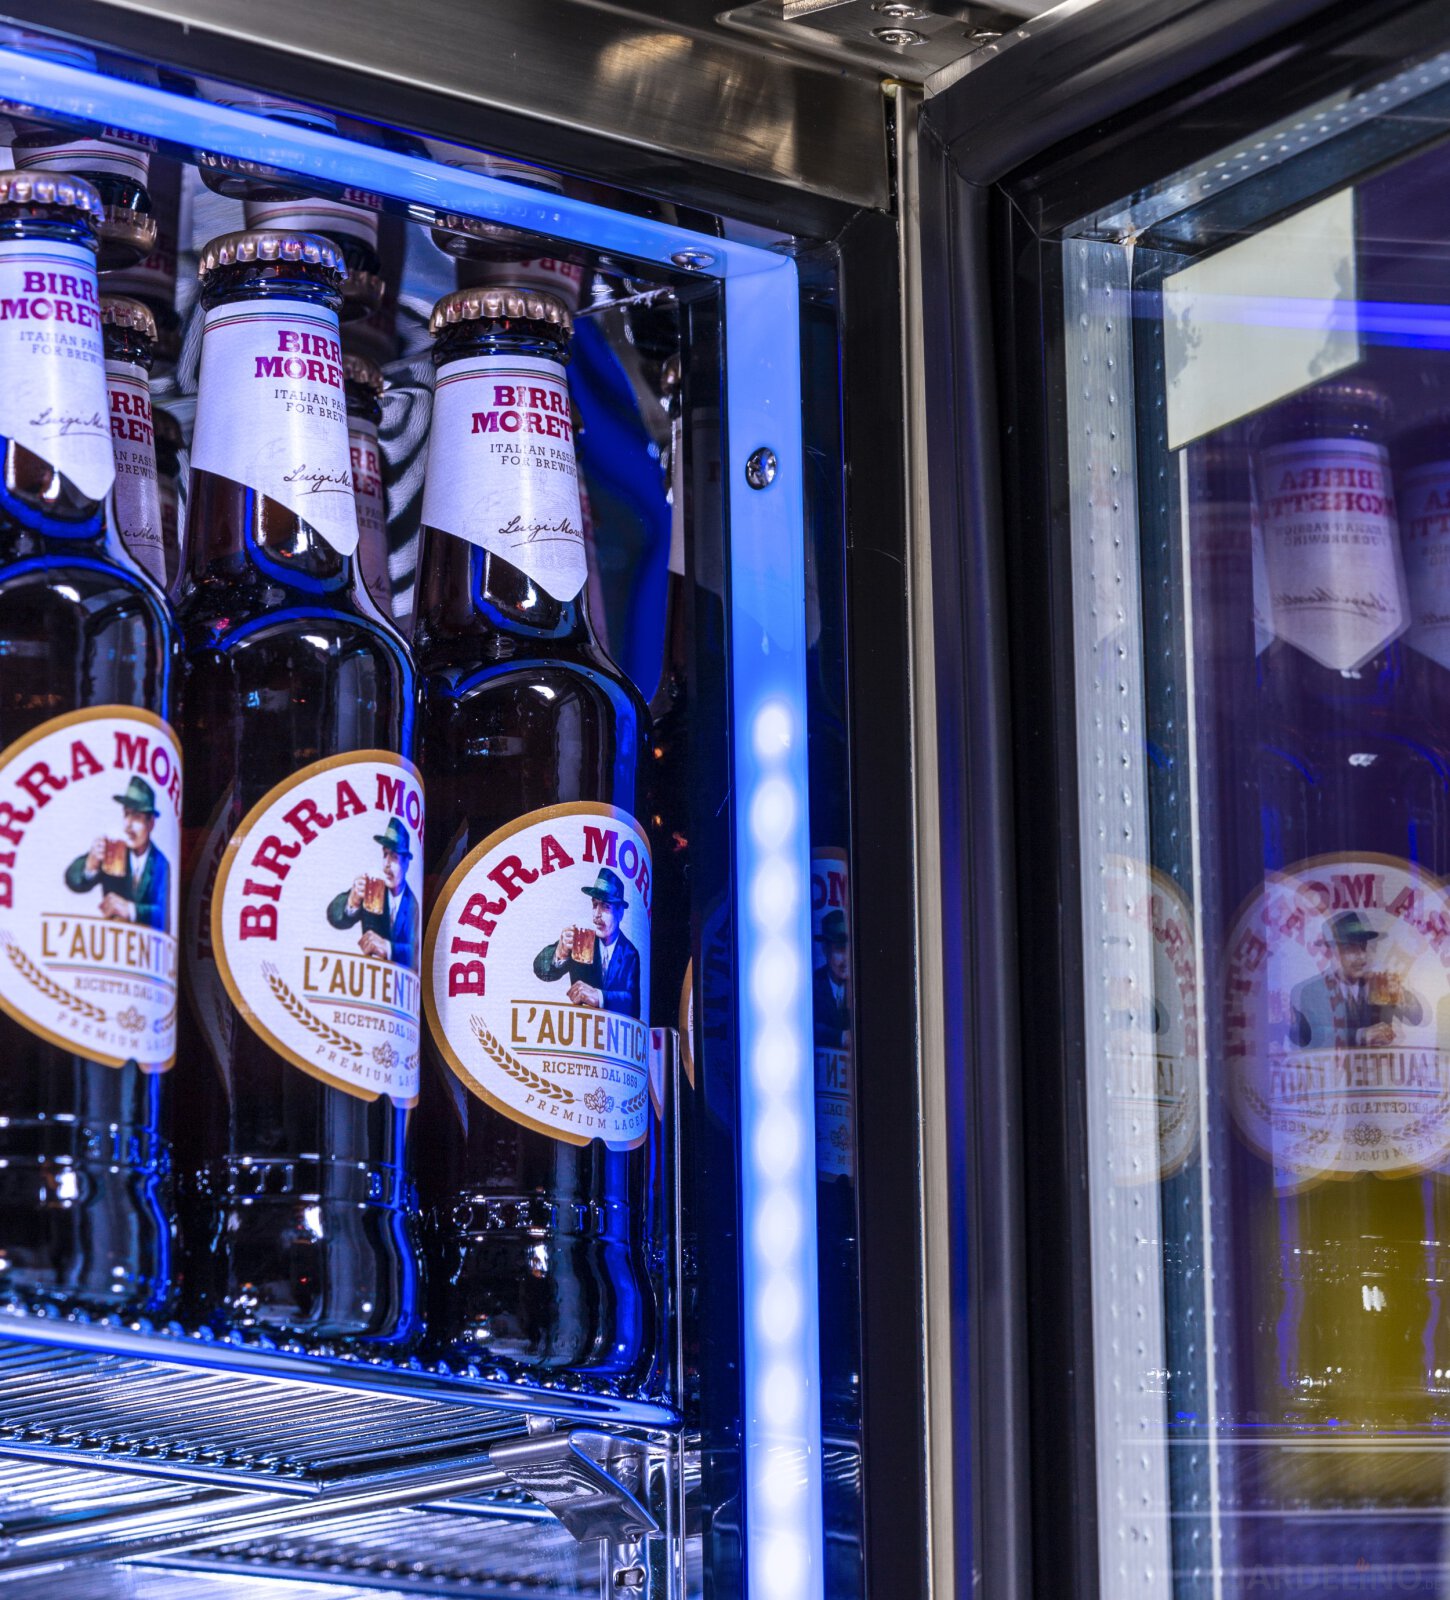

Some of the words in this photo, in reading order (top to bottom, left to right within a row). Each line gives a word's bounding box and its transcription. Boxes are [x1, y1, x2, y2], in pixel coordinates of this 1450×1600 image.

[23, 271, 99, 306] BIRR
[274, 388, 328, 406] ITALIAN
[286, 402, 314, 415] FOR
[471, 410, 574, 443] MORET
[490, 444, 545, 456] ITALIAN
[501, 455, 530, 467] FOR
[498, 515, 551, 542] Luigi
[112, 731, 183, 822] MOR
[239, 779, 368, 941] BIRRA
[449, 833, 575, 998] BIRRA
[583, 825, 652, 919] MOR
[333, 1011, 386, 1032] RICETTA
[388, 1020, 405, 1039] DAL
[316, 1044, 392, 1085] PREMIUM
[542, 1060, 599, 1079] RICETTA
[601, 1067, 621, 1085] DAL
[525, 1093, 607, 1129] PREMIUM
